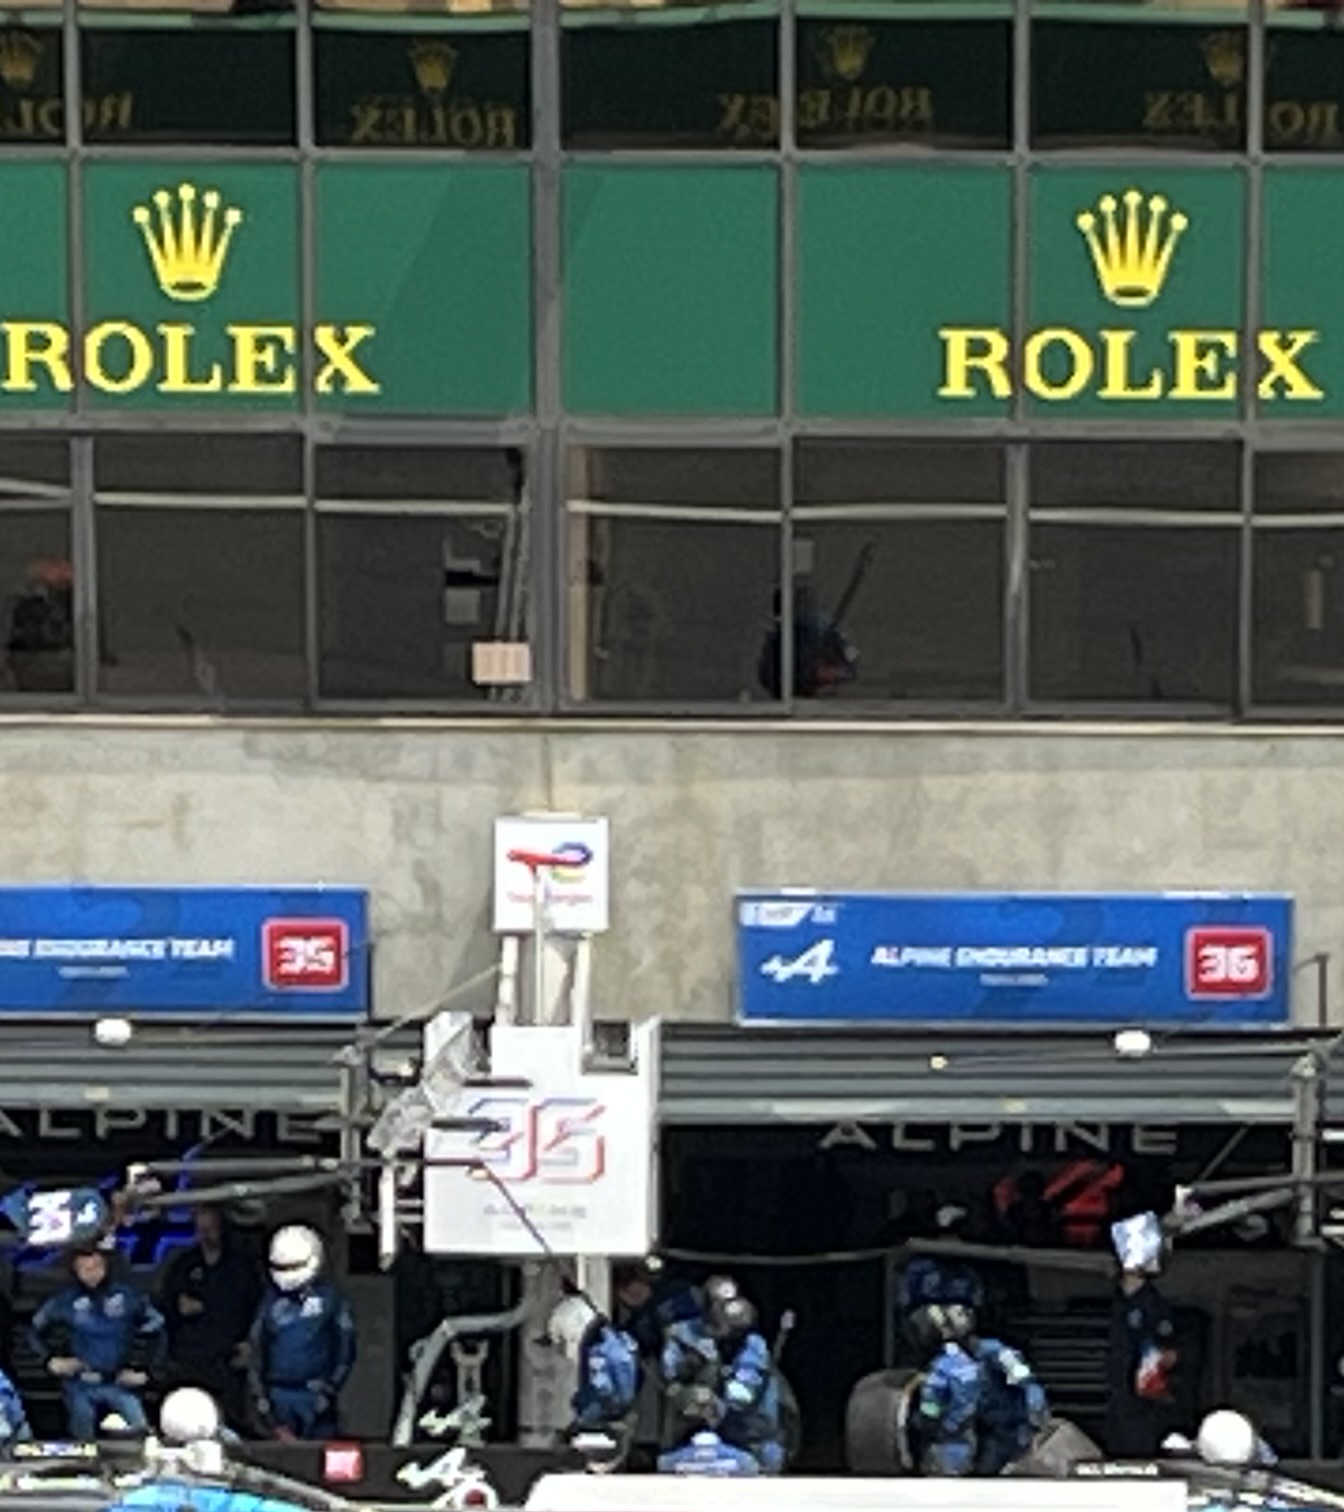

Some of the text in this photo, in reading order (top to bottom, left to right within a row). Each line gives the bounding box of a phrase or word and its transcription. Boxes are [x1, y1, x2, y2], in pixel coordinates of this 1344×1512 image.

[0, 321, 381, 394] ROLEX
[937, 328, 1325, 400] ROLEX
[1197, 944, 1260, 983] 36
[818, 1121, 1179, 1154] ALPINE
